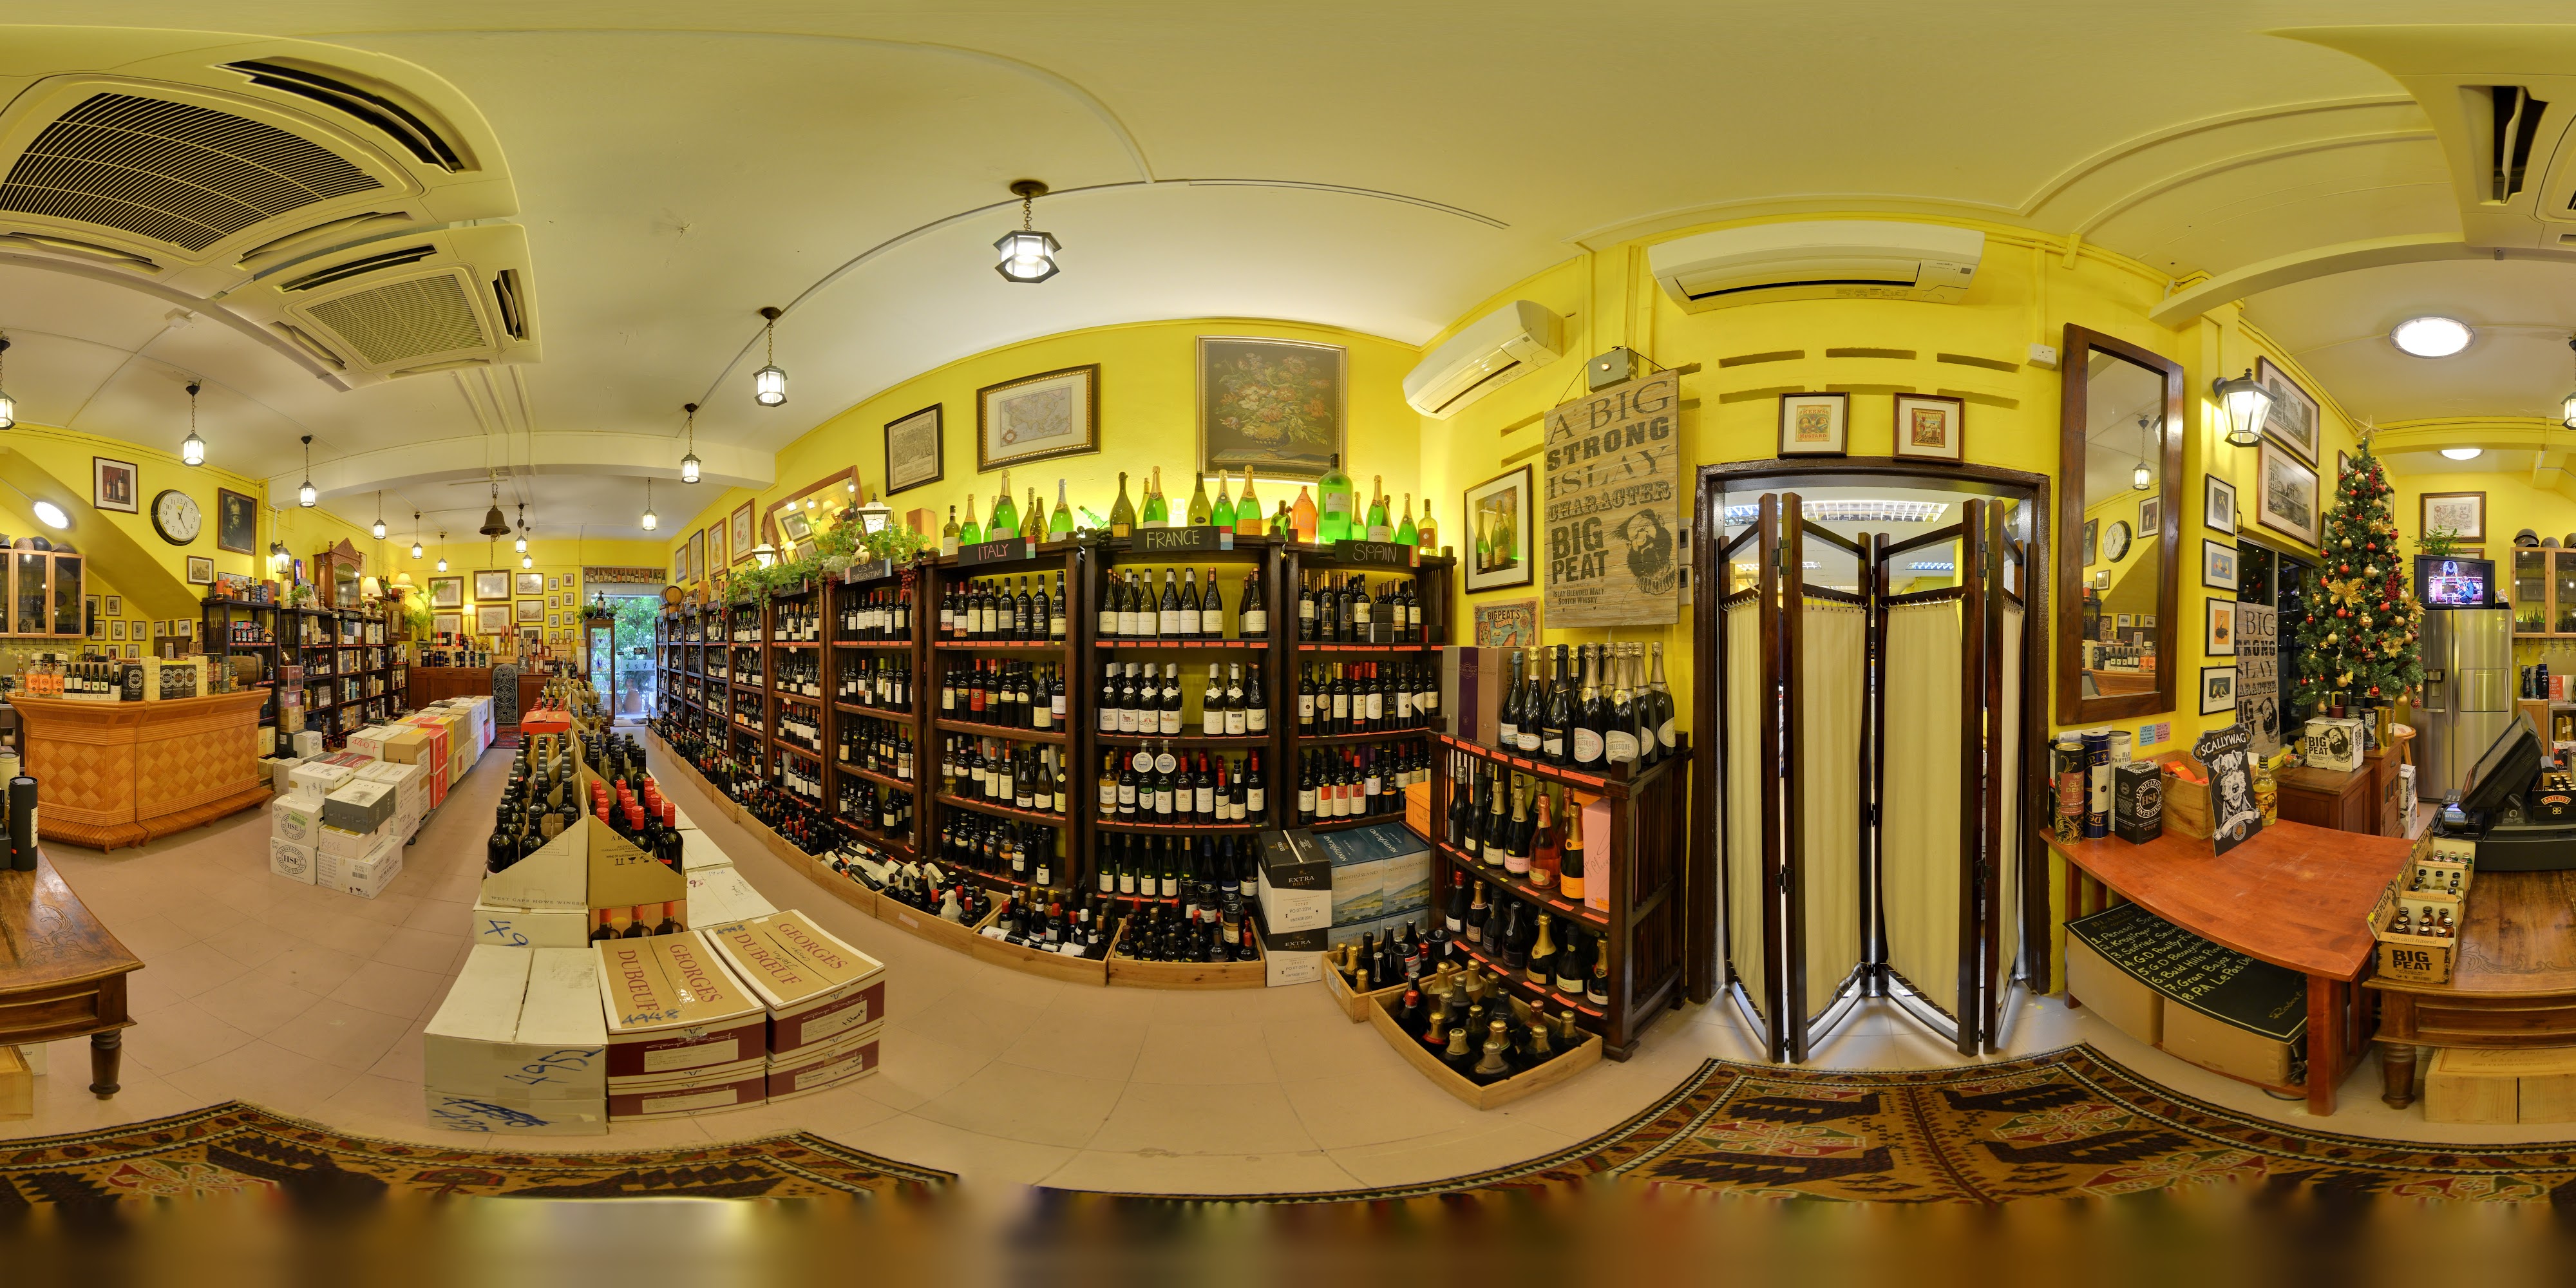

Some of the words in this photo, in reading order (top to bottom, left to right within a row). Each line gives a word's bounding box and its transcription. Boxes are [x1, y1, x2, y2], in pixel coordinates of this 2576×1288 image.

[1547, 413, 1575, 446] A
[1587, 381, 1668, 431] BIG
[1547, 416, 1669, 471] STRONG
[1547, 444, 1670, 500] ISLAY
[1548, 480, 1671, 523] CHARACTER
[1146, 529, 1200, 549] FRANCE
[1551, 516, 1604, 561] BIG
[978, 544, 1009, 561] ITALY
[1353, 544, 1397, 563] SPAIN
[852, 569, 883, 581] ARGENTINA
[1552, 549, 1609, 585] PEAT
[1488, 611, 1497, 620] BIG
[1498, 609, 1520, 620] PEAT'S
[2245, 611, 2275, 636] BIG
[1497, 620, 1510, 628] ISLAY
[2236, 639, 2275, 657] TRONG
[2237, 660, 2276, 679] SLAY
[2238, 679, 2277, 697] ARACTER
[2201, 732, 2246, 757] SCALLYWAG
[2211, 731, 2226, 740] SWEET
[2308, 736, 2327, 747] BIG
[352, 738, 379, 753] 4407
[2309, 746, 2328, 755] PEAT
[2141, 791, 2157, 806] HSE
[287, 822, 299, 831] HSE
[278, 846, 304, 860] HABITATION
[284, 855, 299, 866] HSE
[1289, 875, 1314, 884] EXTRA
[2374, 907, 2382, 924] BIG
[2379, 896, 2391, 914] PEAT
[2155, 926, 2184, 939] Sauvig
[779, 923, 848, 969] GEORGES
[733, 933, 802, 985] DUBŒUF
[2183, 955, 2207, 967] Hills
[2202, 945, 2224, 956] Pino
[2202, 956, 2231, 972] Bajoz
[2392, 949, 2429, 962] BIG
[670, 944, 723, 1003] GEORGES
[2392, 960, 2432, 971] PEAT
[618, 950, 660, 1011] DUBŒUF
[621, 1009, 681, 1025] 4948
